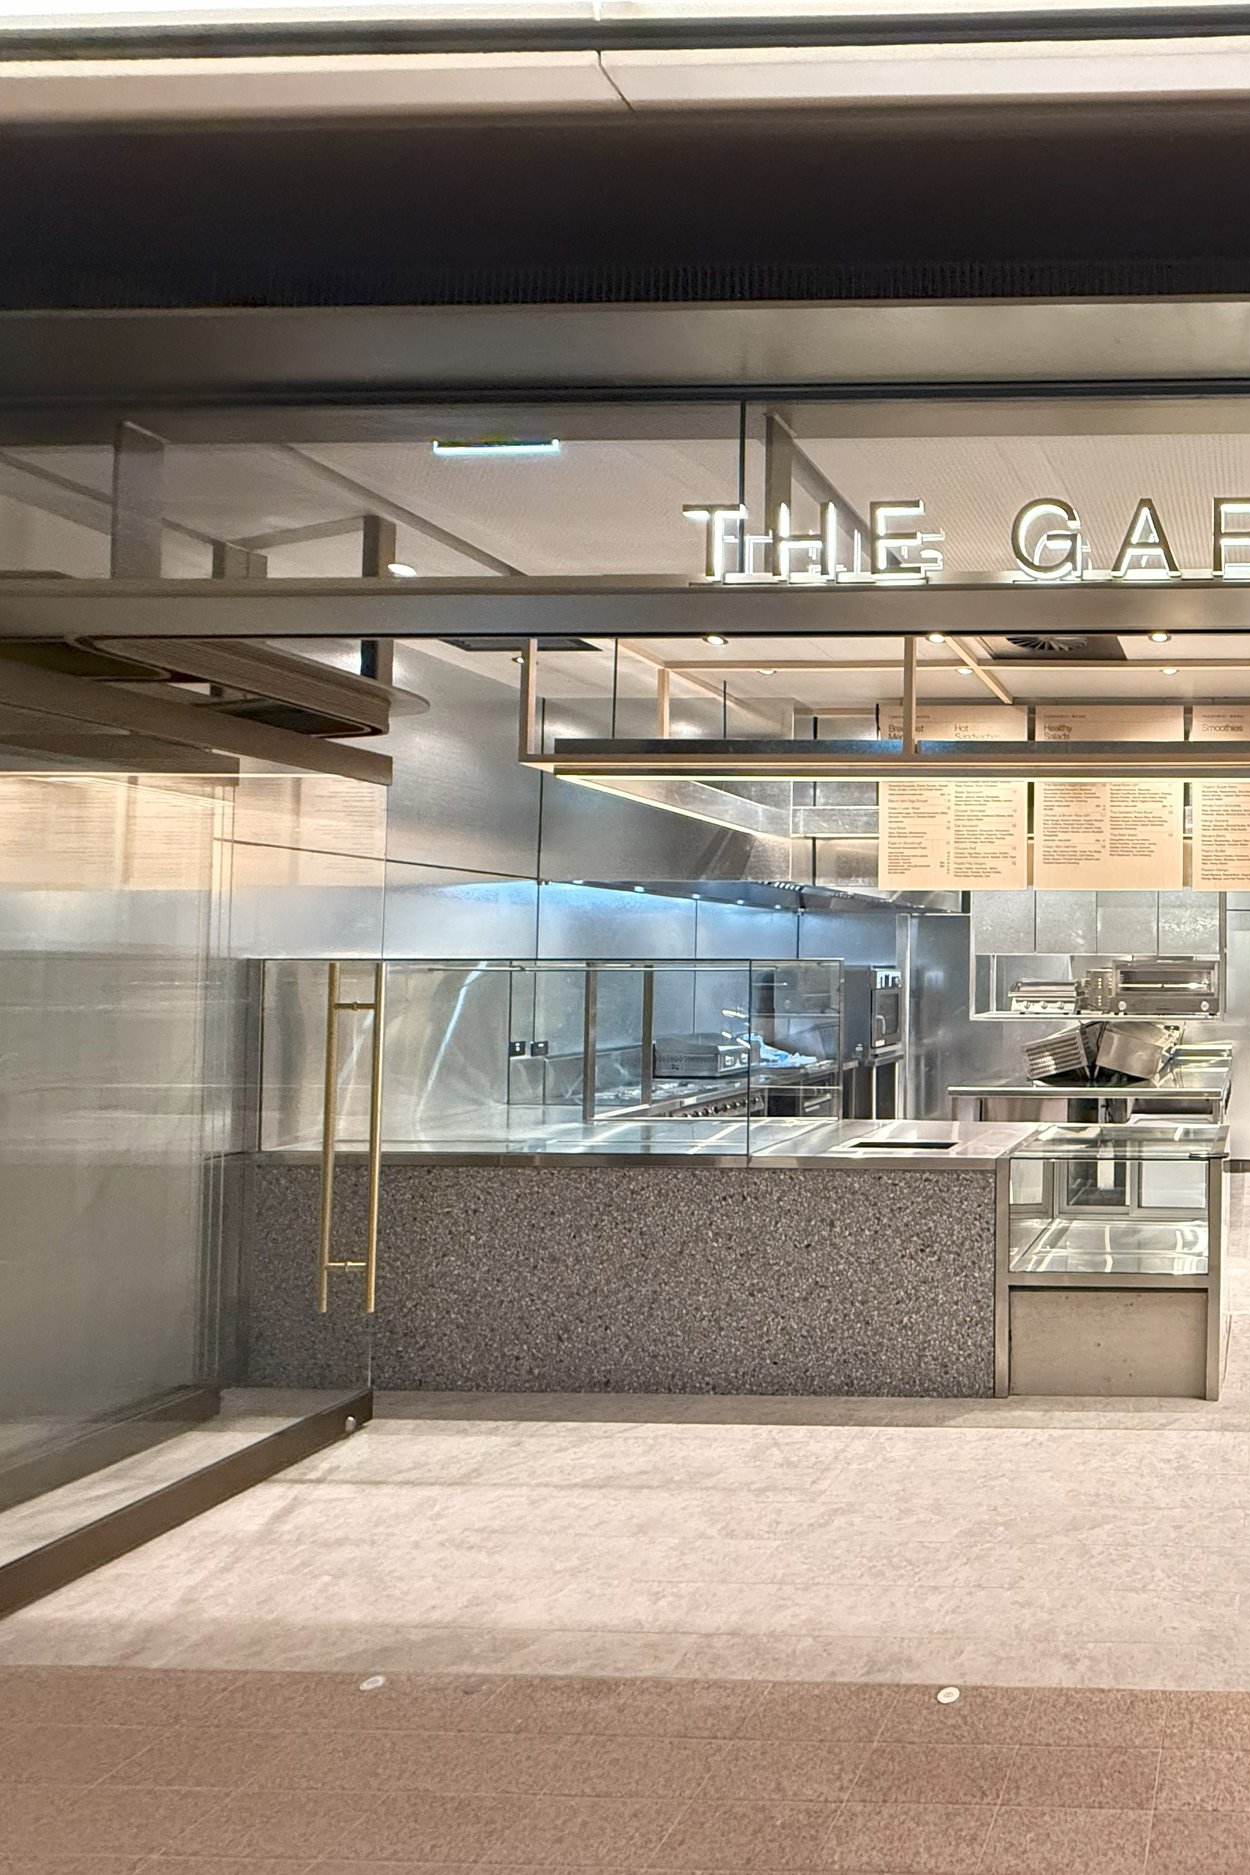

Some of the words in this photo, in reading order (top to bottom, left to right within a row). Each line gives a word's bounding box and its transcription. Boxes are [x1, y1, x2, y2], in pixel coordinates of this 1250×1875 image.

[682, 499, 926, 583] THE
[1044, 724, 1072, 733] Healthy
[1202, 723, 1243, 732] Smoothies
